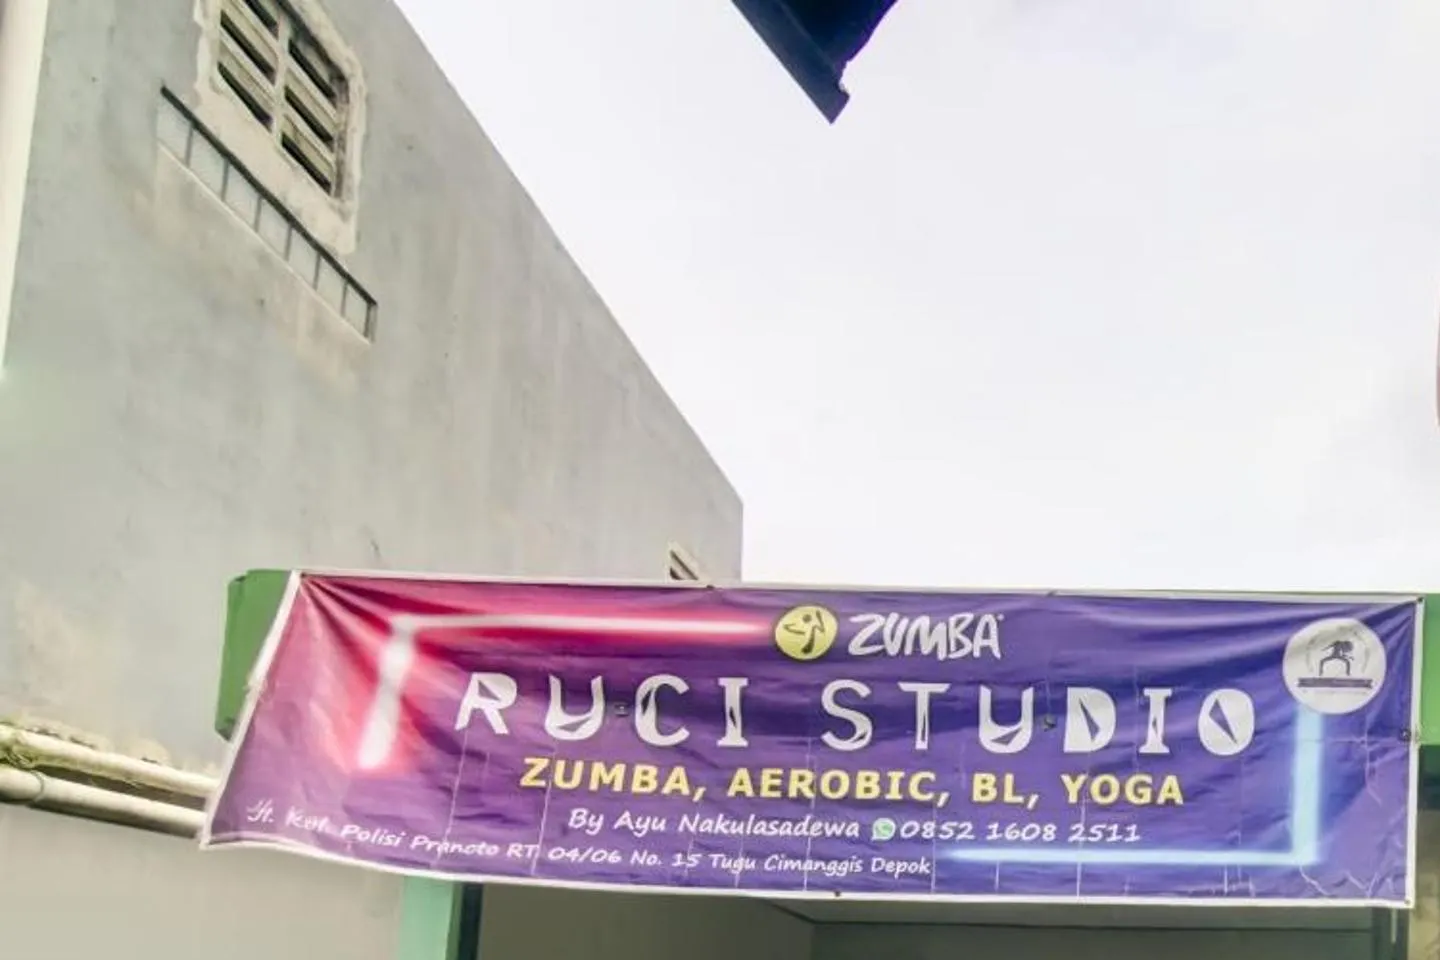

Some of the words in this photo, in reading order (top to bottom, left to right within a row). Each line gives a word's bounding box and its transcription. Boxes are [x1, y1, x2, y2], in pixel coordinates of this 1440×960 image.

[848, 612, 1003, 660] ZUMBA
[455, 672, 750, 748] RUCI
[820, 679, 1255, 756] STUDIO
[519, 757, 706, 801] ZUMBA,
[727, 767, 950, 808] AEROBIC,
[972, 773, 1038, 810] BL,
[1062, 775, 1184, 806] YOGA
[340, 824, 404, 846] Polisi
[506, 842, 540, 859] RT
[547, 846, 621, 864] 04/06
[630, 850, 662, 867] No.
[671, 854, 702, 868] 15
[709, 853, 757, 874] Tugu
[763, 854, 863, 877] Cimanggis
[871, 857, 931, 877] Depok
[568, 807, 604, 834] By
[613, 811, 667, 837] Ayu
[678, 813, 860, 839] Nakulasadewa
[899, 820, 975, 841] 0852
[985, 821, 1057, 842] 1608
[1067, 823, 1142, 843] 2511
